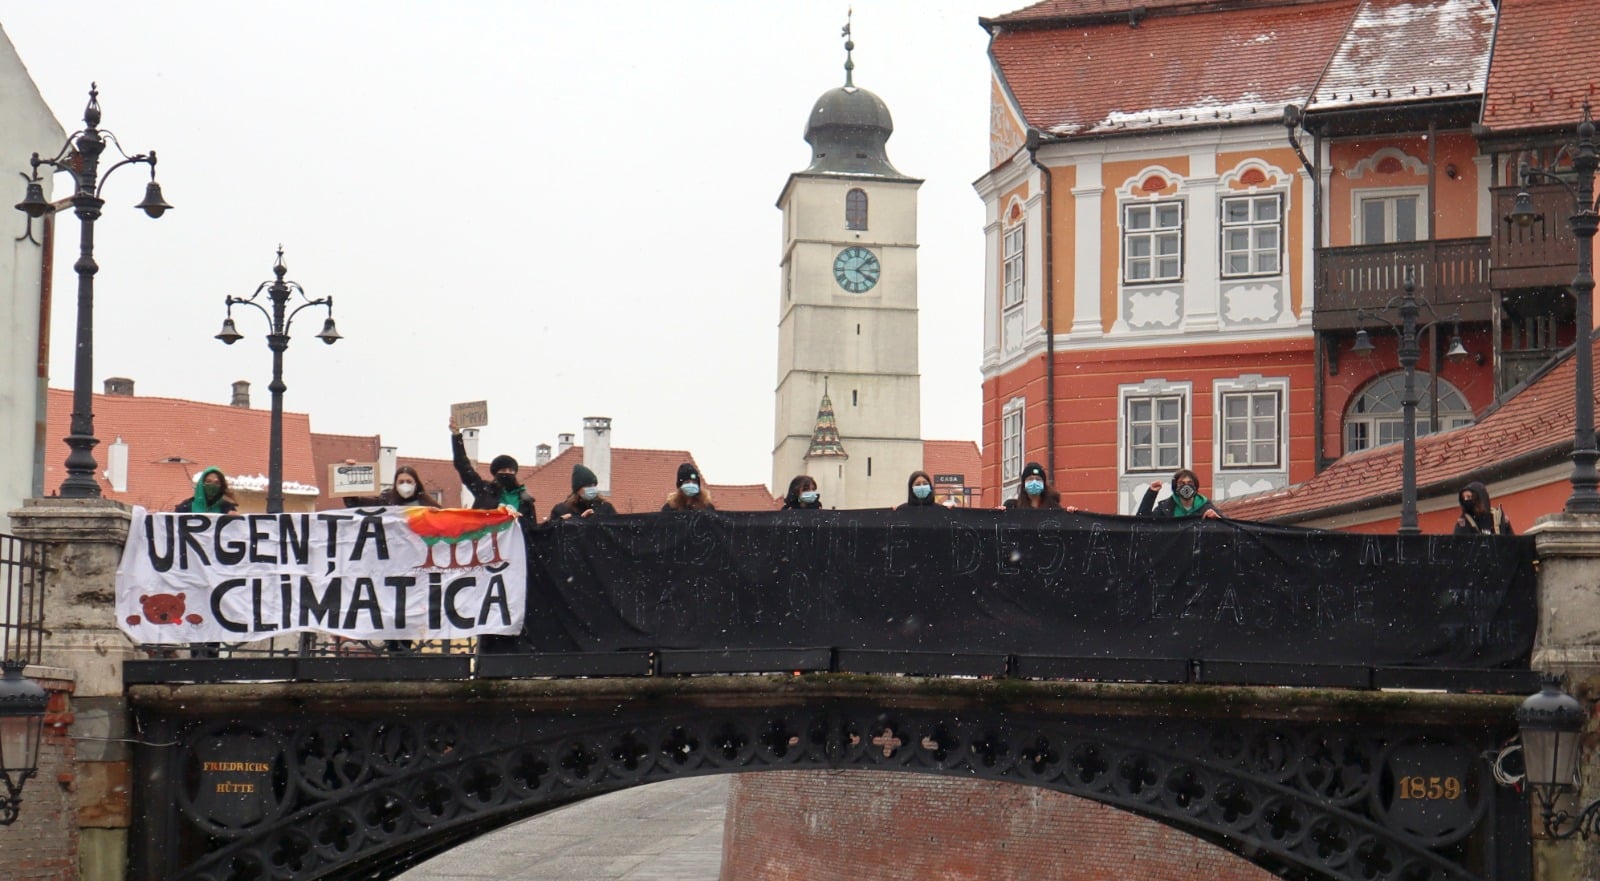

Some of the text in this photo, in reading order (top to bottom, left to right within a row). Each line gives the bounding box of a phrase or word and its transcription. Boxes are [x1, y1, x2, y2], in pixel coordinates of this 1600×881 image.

[144, 507, 391, 577] URGENȚĂ
[203, 761, 270, 772] FRIEDRICHS
[216, 781, 254, 793] HÜTTE
[1399, 776, 1461, 800] 1859
